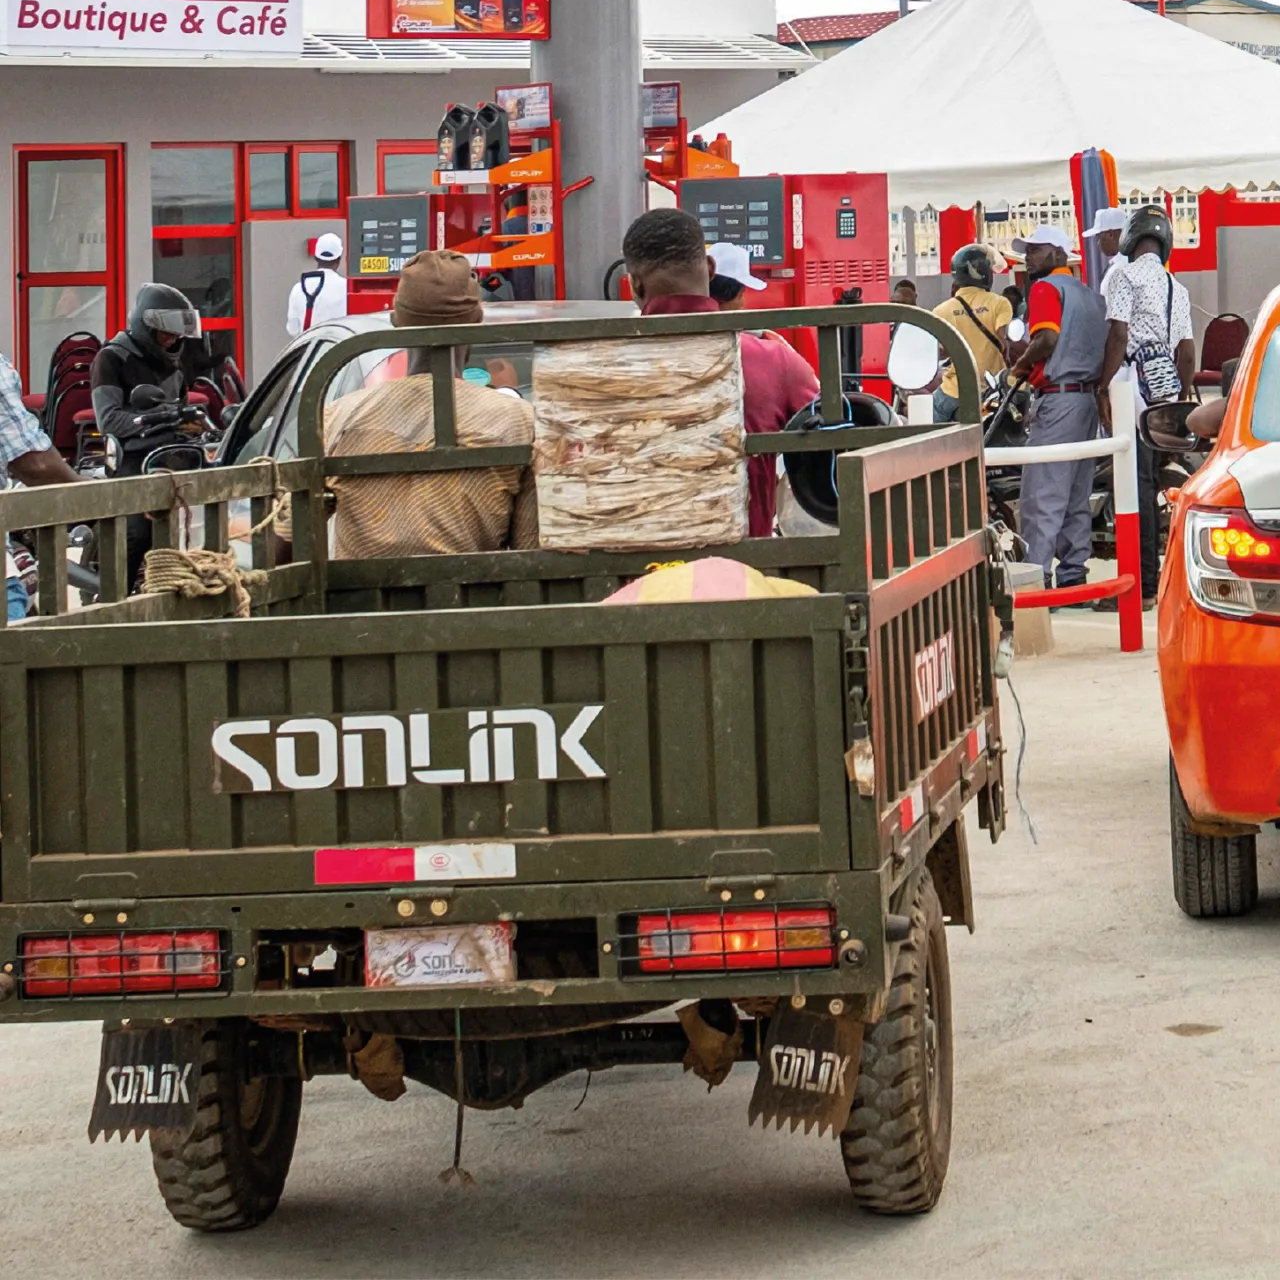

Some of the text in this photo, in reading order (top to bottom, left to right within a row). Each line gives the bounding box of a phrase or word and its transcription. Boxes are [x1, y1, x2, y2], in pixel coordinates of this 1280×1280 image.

[17, 0, 287, 40] Boutique & Café
[361, 258, 388, 270] GASOIL
[211, 705, 607, 792] SONLINK
[105, 1062, 193, 1105] SONLINK
[769, 1044, 851, 1097] SONLINK
